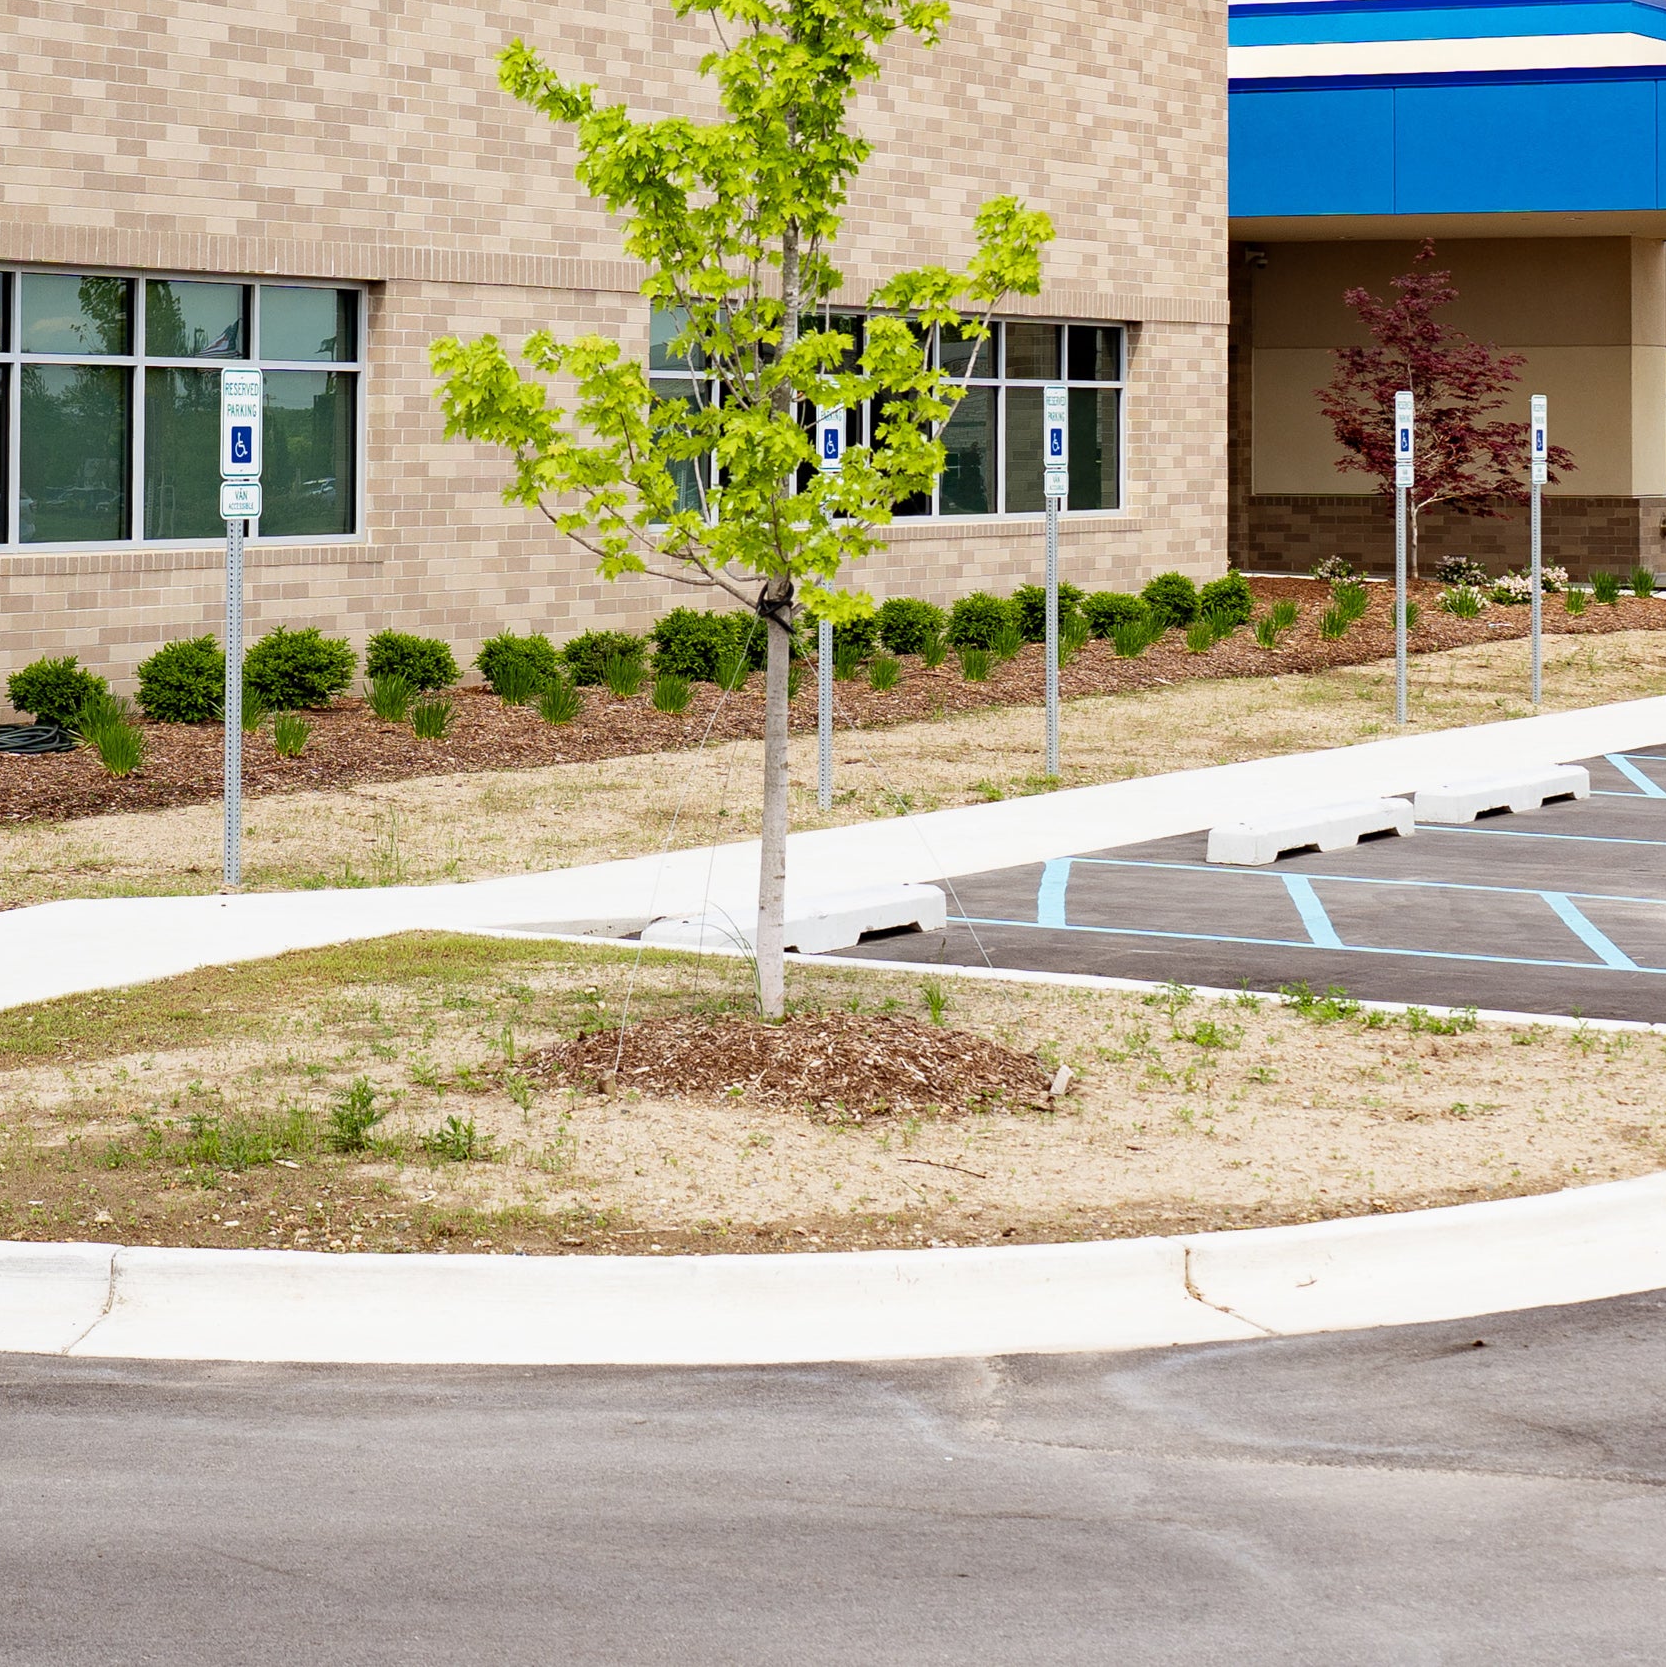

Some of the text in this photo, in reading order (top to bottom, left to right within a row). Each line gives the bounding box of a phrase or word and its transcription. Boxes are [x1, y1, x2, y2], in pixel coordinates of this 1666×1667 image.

[225, 382, 258, 396] RESERVED
[227, 403, 257, 418] PARKING
[235, 489, 248, 501] VAN
